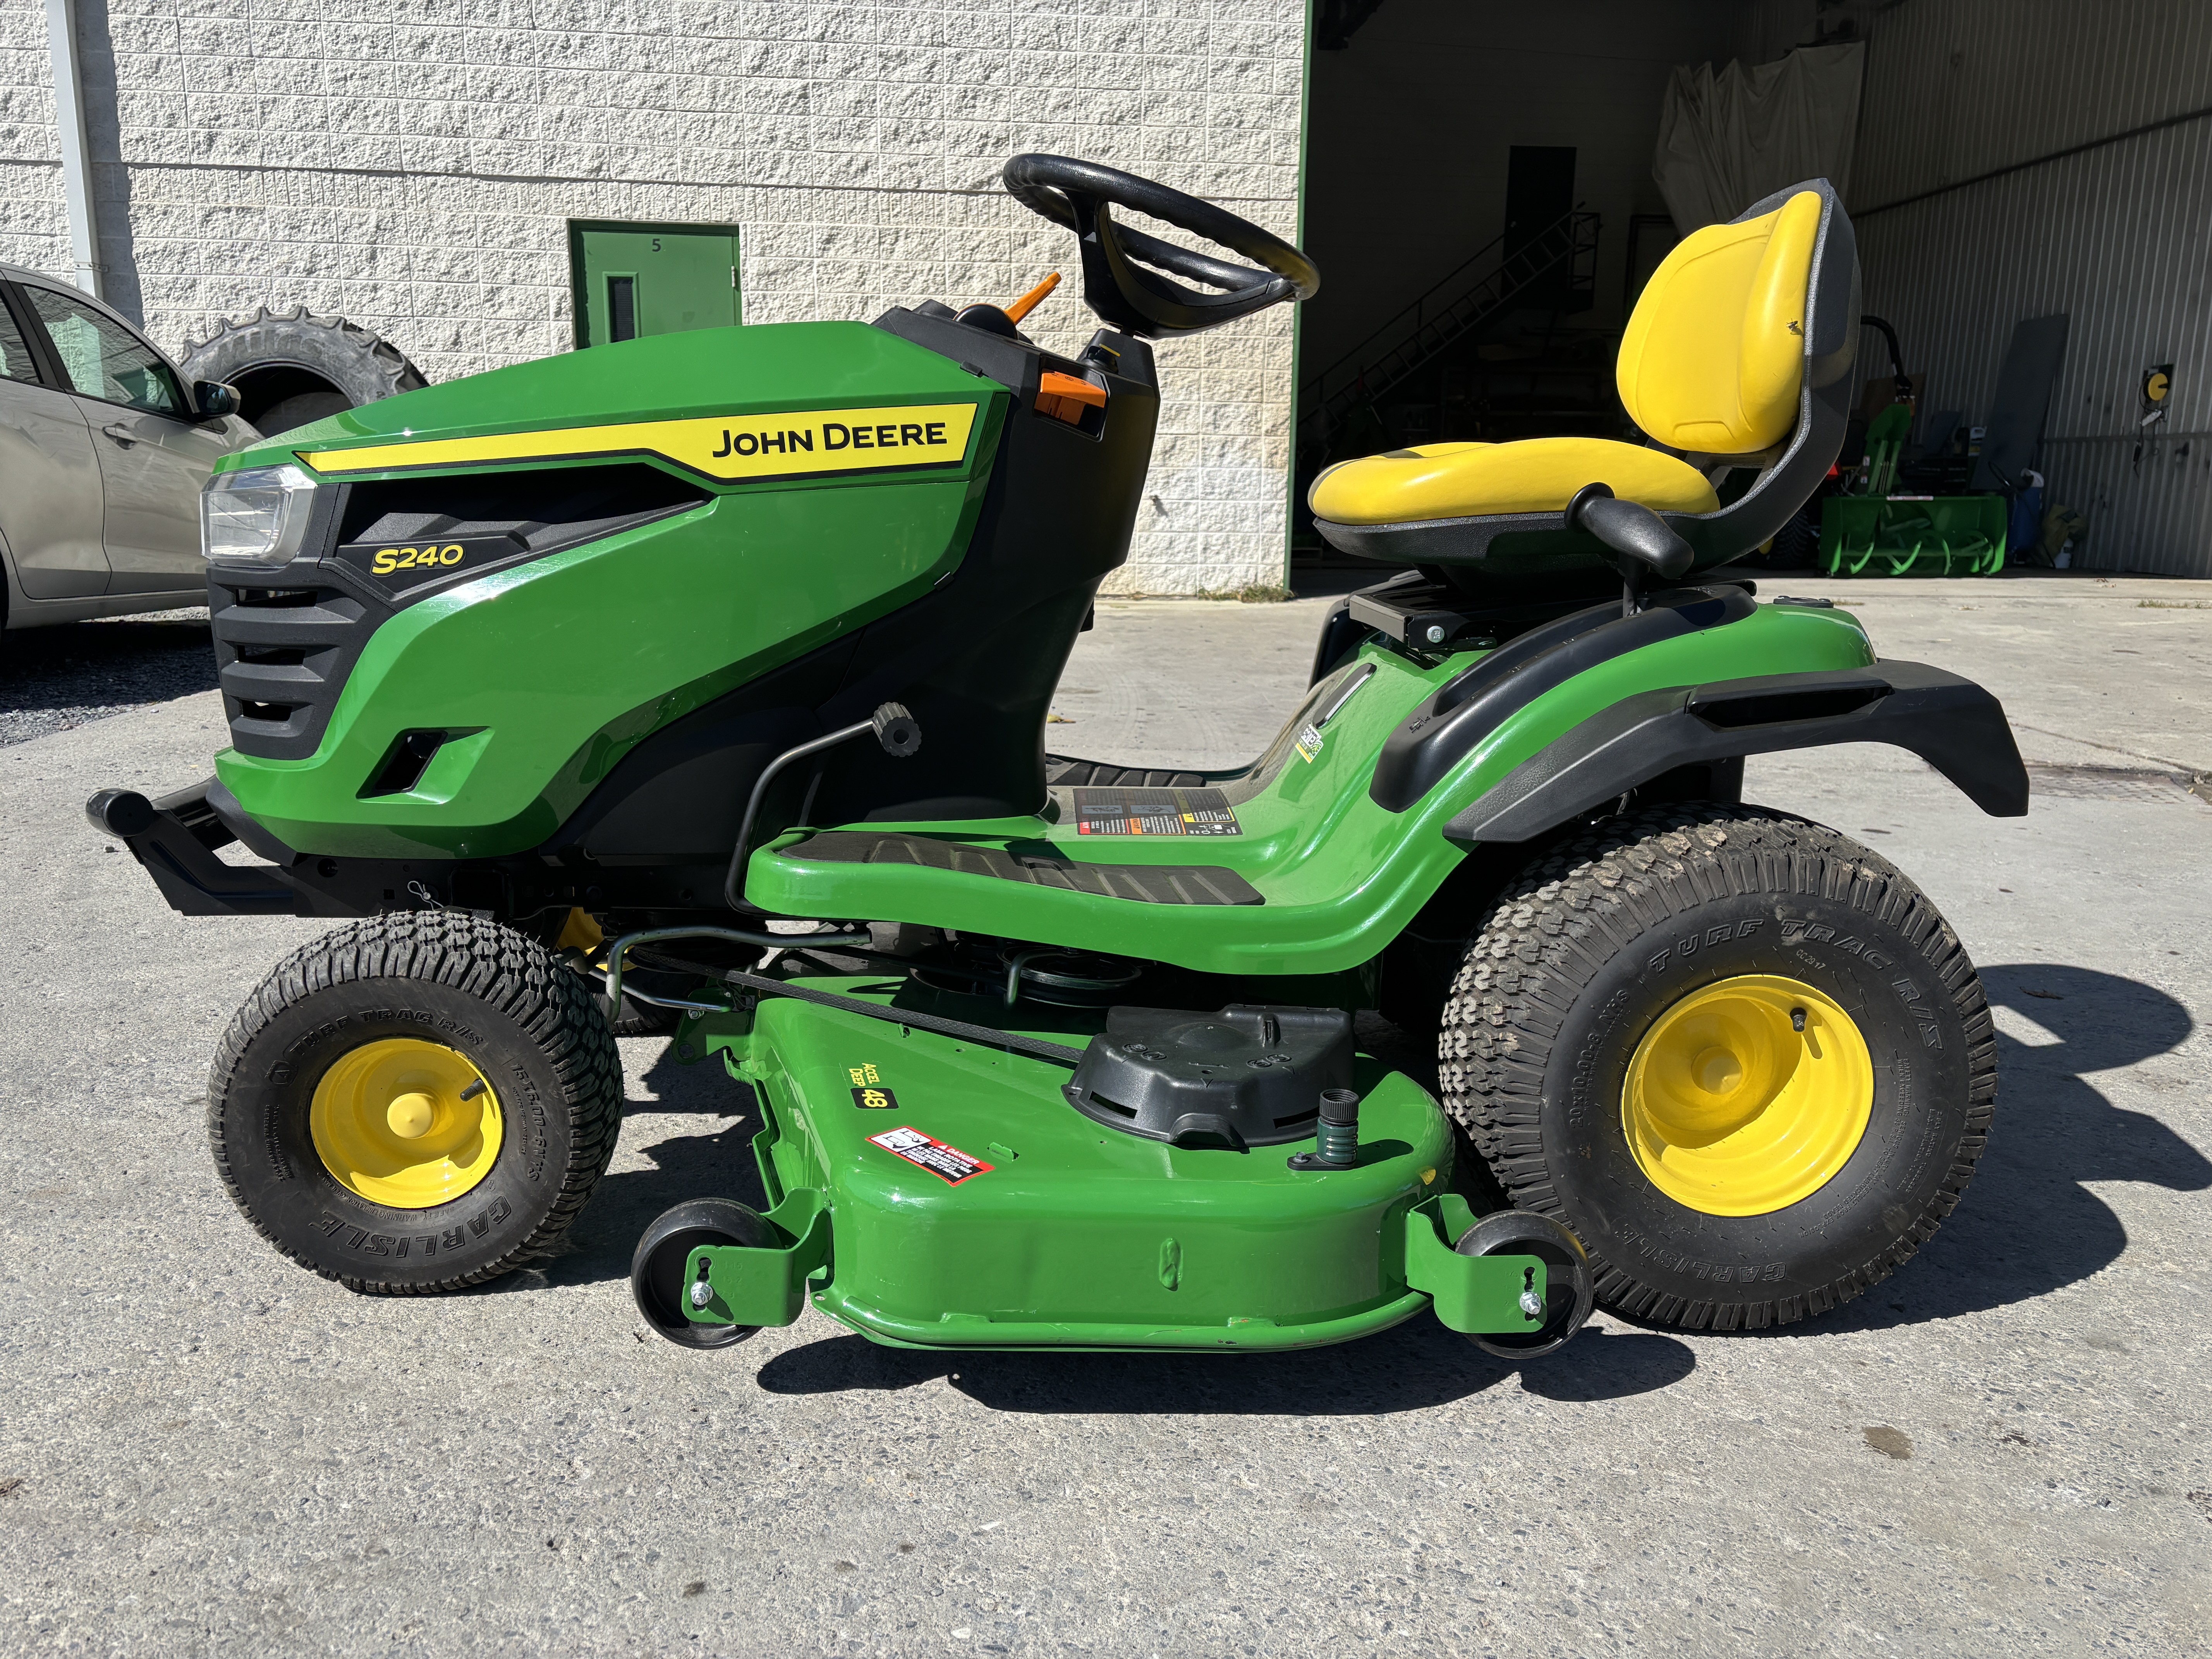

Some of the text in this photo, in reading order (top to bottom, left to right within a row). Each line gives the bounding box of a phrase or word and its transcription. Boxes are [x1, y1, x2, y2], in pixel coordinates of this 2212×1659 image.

[652, 238, 661, 252] 5
[713, 422, 947, 458] JOHN DEERE
[372, 544, 463, 574] S240
[1649, 919, 1943, 1050] TURF TRAC R/S
[1599, 990, 1630, 1025] NHS
[290, 1009, 483, 1056] TURF TRAC R/S
[849, 1063, 880, 1086] ACCEL DEEP
[862, 1089, 888, 1107] 48
[1893, 1121, 1906, 1149] SERIOUS
[929, 1147, 973, 1168] LAME ROTATIVE
[946, 1148, 980, 1164] DANGER
[1872, 1156, 1885, 1172] SEAT
[1881, 1150, 1896, 1172] INJURY
[1844, 1173, 1874, 1204] LUBRICATED
[309, 1195, 512, 1258] CARLISLE
[1615, 1224, 1786, 1283] CARLISLE
